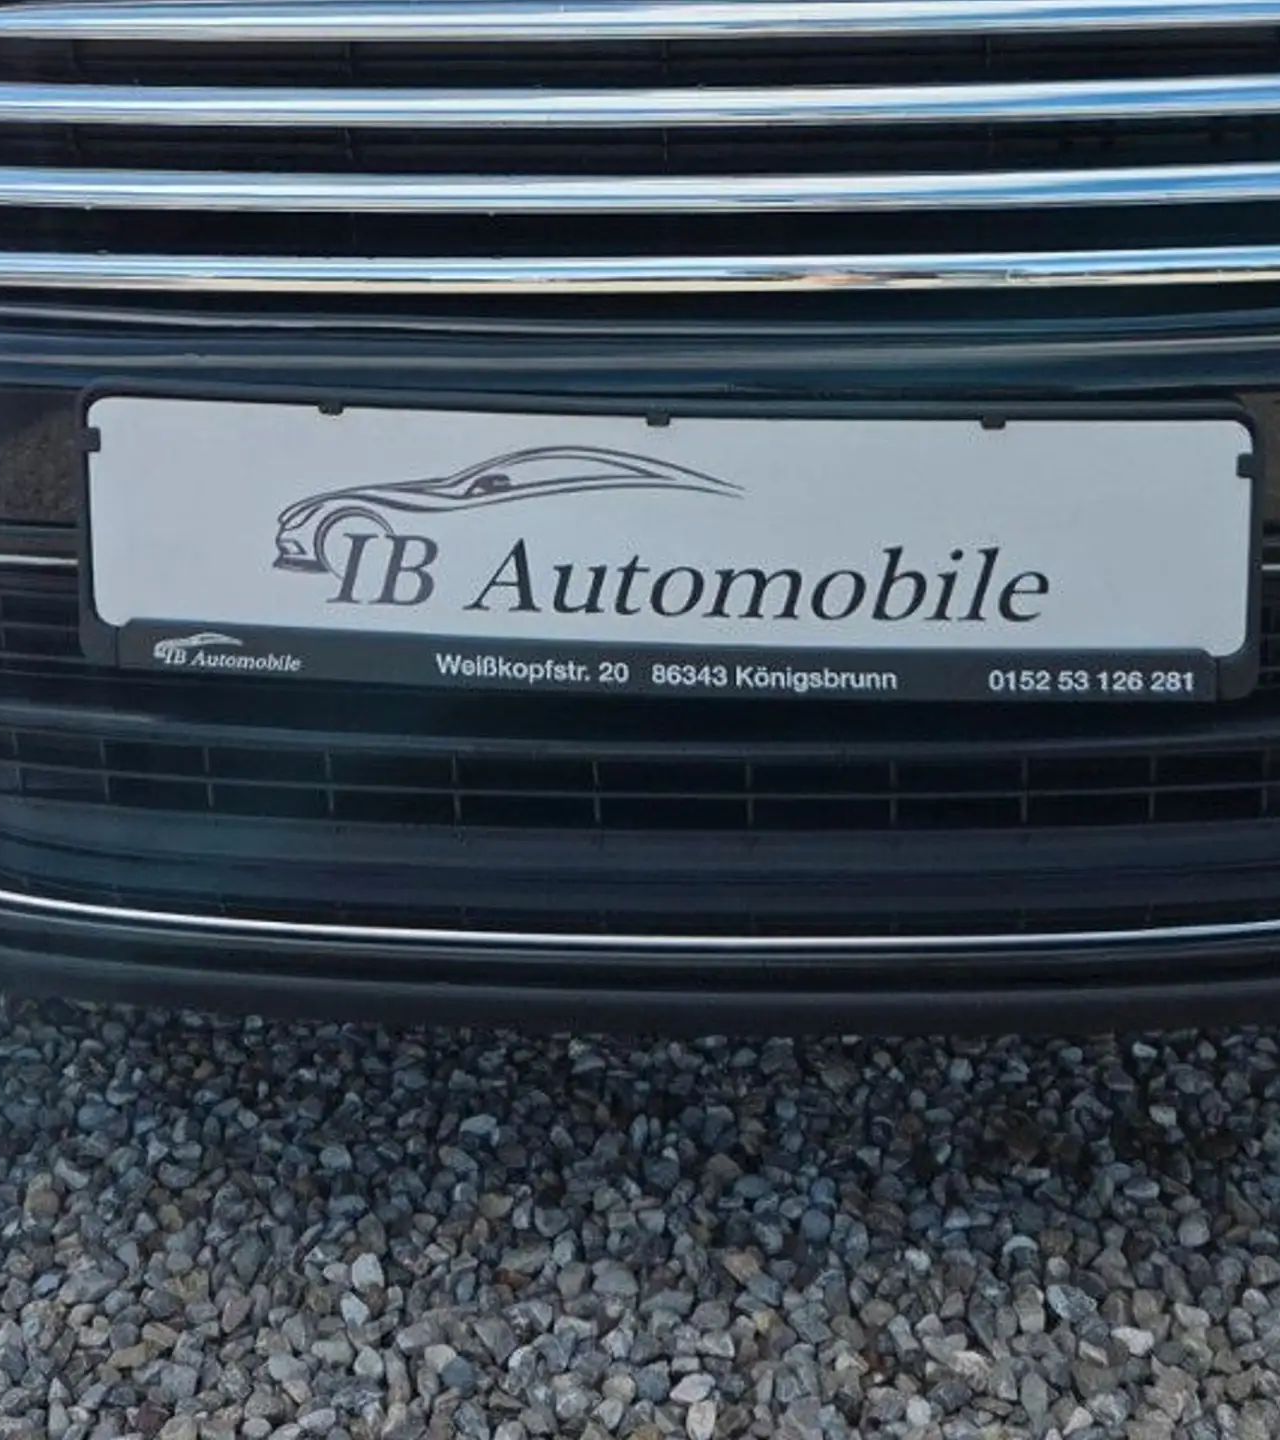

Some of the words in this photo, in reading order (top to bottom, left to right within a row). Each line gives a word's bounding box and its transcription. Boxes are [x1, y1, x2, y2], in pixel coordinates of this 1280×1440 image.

[325, 532, 439, 606] IB
[462, 537, 1049, 623] Automobile
[190, 650, 303, 672] Automobile
[435, 653, 592, 684] Weißkopfstr.
[598, 661, 630, 683] 20
[651, 664, 728, 686] 86343
[735, 665, 898, 693] Königsbrunn
[988, 669, 1051, 691] 0152
[1057, 670, 1090, 691] 53
[1097, 671, 1144, 691] 126
[1150, 671, 1195, 691] 281
